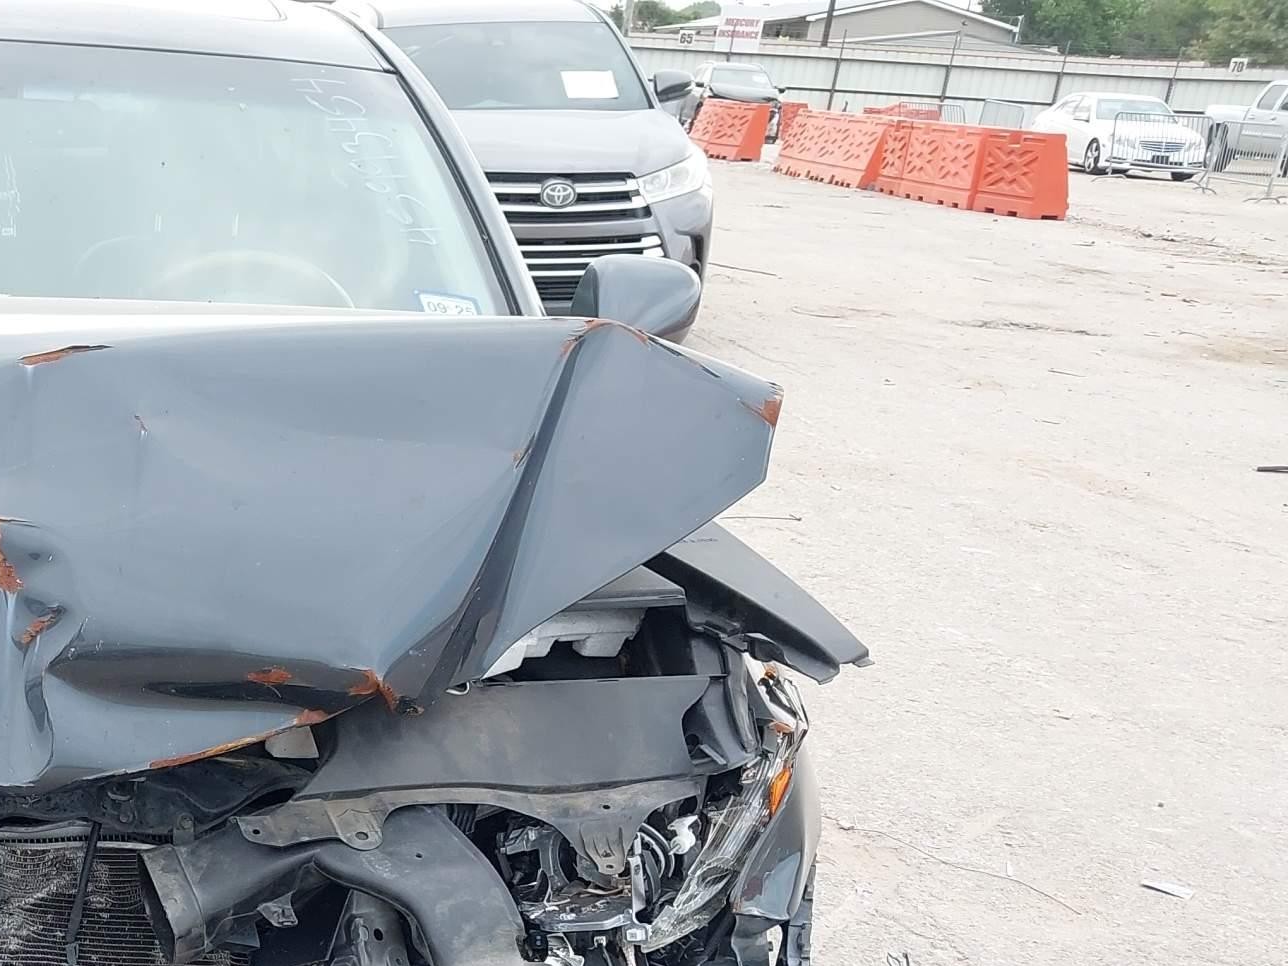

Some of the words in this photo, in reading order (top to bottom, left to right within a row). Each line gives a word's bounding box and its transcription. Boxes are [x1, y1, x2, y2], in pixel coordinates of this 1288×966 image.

[725, 17, 760, 27] MERCURY
[680, 33, 694, 44] 65
[1231, 61, 1245, 72] 70
